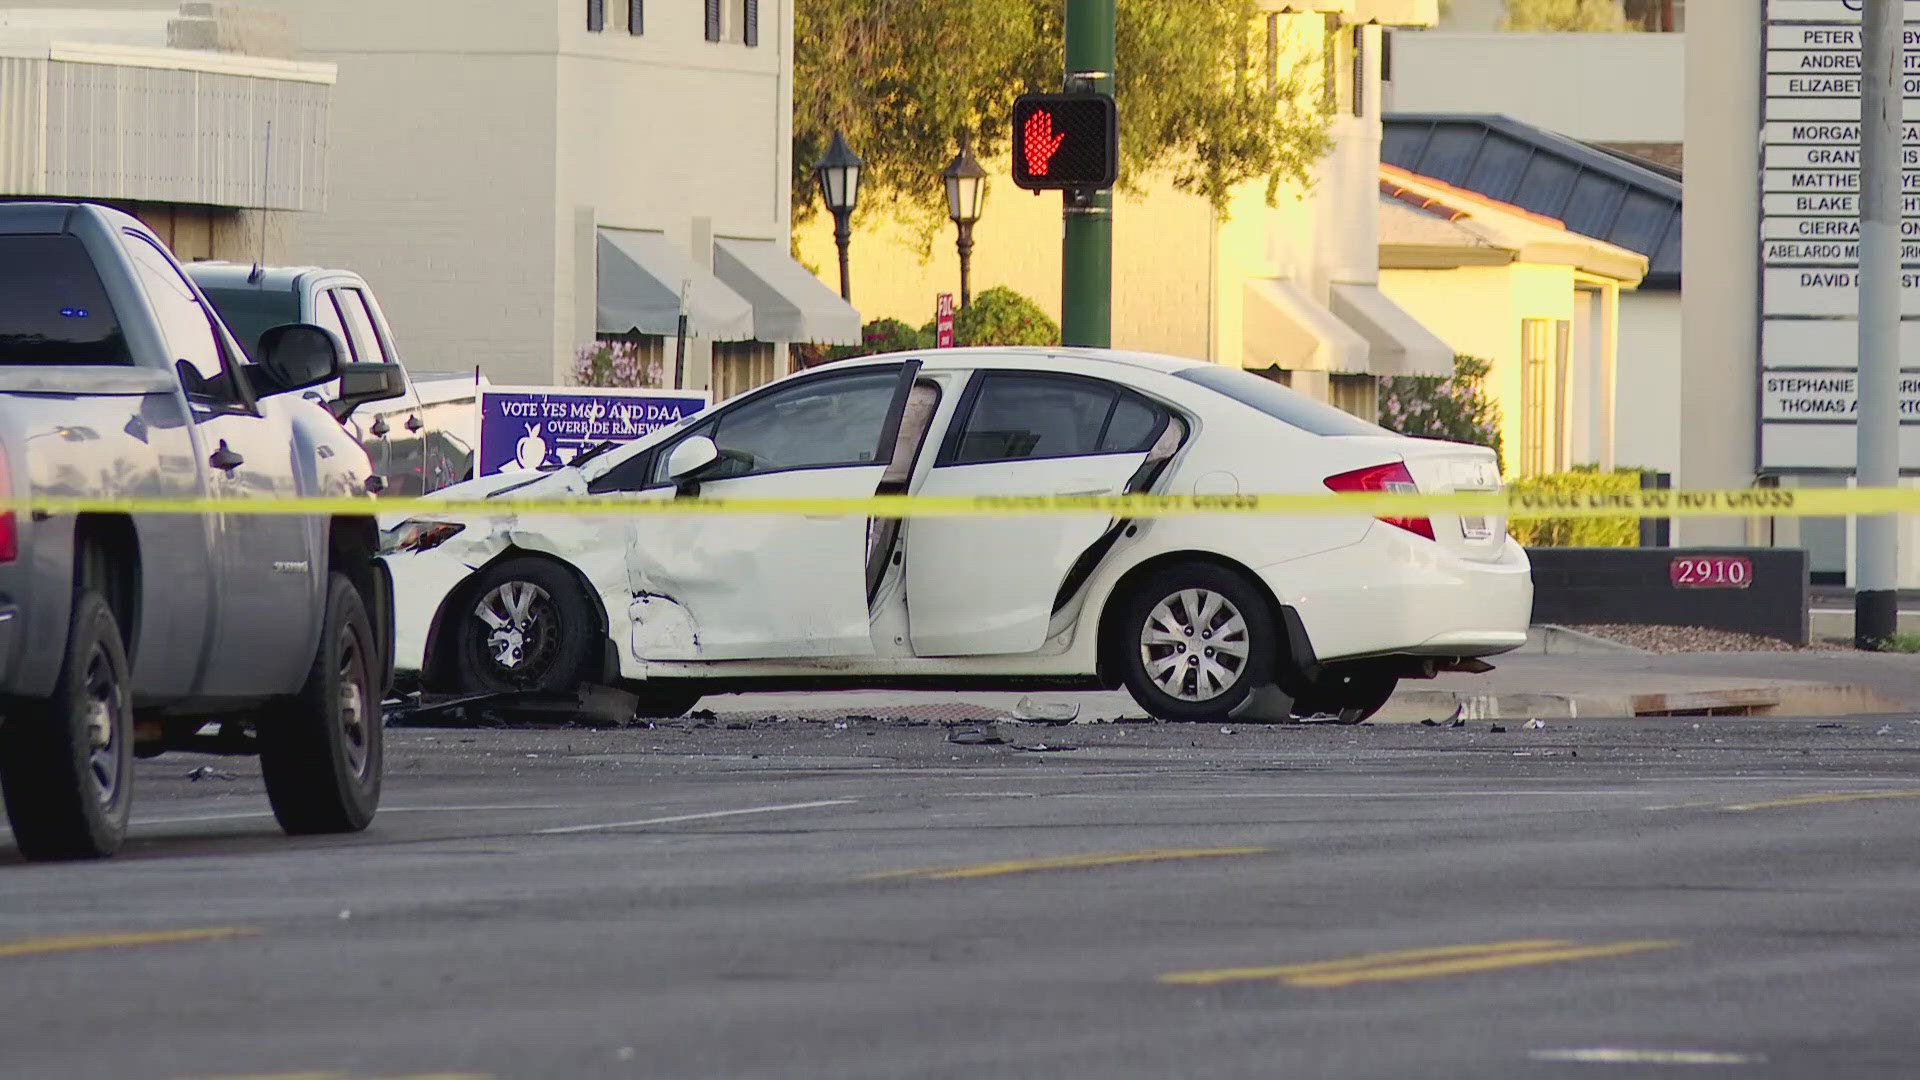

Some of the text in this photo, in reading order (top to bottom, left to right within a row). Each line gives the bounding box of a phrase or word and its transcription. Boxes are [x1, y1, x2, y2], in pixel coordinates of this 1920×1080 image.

[1803, 31, 1855, 44] PETER
[1789, 79, 1860, 92] ELIZABET
[1792, 174, 1860, 187] MATTHE
[1796, 197, 1853, 210] BLAKE
[1799, 221, 1860, 235] CIERRA
[1769, 245, 1841, 258] ABELARDO
[1801, 273, 1850, 287] DAVID
[1767, 378, 1855, 392] STEPHANIE
[501, 402, 538, 417] VOTE
[541, 402, 567, 417] YES
[609, 404, 644, 419] AND
[647, 405, 682, 420] DAA
[1779, 399, 1846, 412] THOMAS
[547, 421, 610, 434] OVERRIDE
[1678, 560, 1745, 583] 2910
